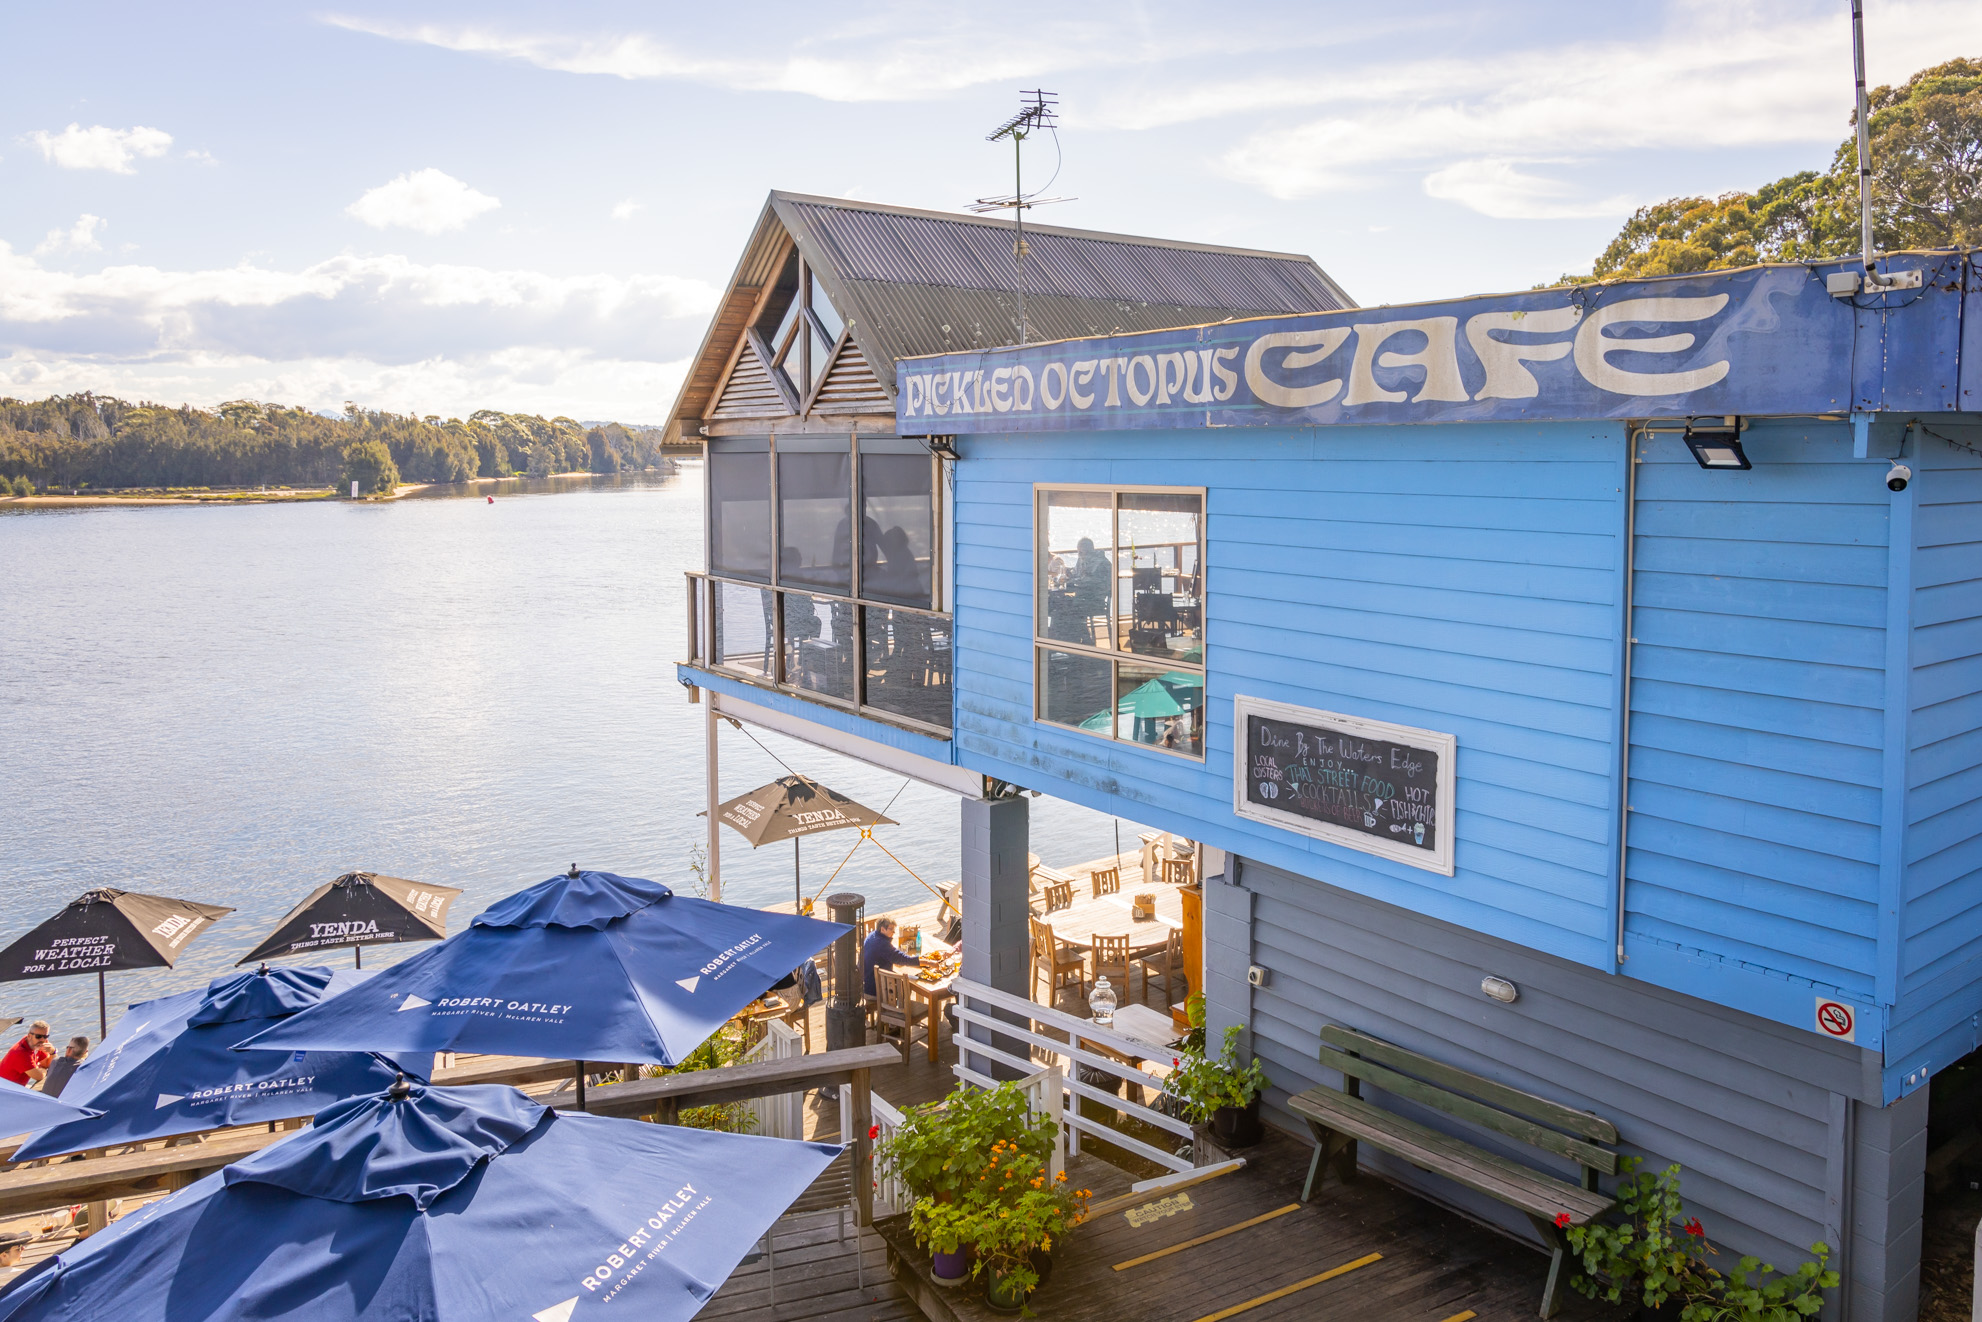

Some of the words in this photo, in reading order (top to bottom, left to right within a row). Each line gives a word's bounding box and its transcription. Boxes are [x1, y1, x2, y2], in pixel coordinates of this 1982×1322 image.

[905, 366, 1034, 417] PICKLED
[1040, 346, 1239, 411] OCTOPUS
[1244, 292, 1730, 408] CAFE
[1261, 725, 1290, 748] Dine
[1295, 731, 1310, 759] By
[1314, 735, 1334, 755] The
[1339, 739, 1383, 764] Waters
[1390, 747, 1423, 778] Edge
[1254, 755, 1278, 769] LOCAL
[1253, 766, 1284, 781] OYSTERS
[1285, 763, 1313, 784] THAI
[1317, 768, 1359, 789] STREET
[1360, 775, 1395, 800] FOOD
[1302, 782, 1372, 812] COCKTAILS
[1404, 786, 1430, 804] HOT
[792, 808, 846, 825] YENDA
[1343, 805, 1363, 823] BEER
[310, 919, 380, 938] YENDA
[51, 935, 109, 947] PERFECT
[291, 940, 319, 949] THINGS
[320, 937, 345, 945] TASTE
[346, 933, 374, 942] BETTER
[34, 944, 116, 961] WEATHER
[700, 948, 737, 975] ROBERT
[733, 933, 762, 952] OATLEY
[22, 964, 46, 973] FOR
[47, 963, 55, 971] A
[58, 955, 112, 970] LOCAL
[431, 1009, 470, 1017] MARGARET
[470, 1009, 495, 1017] RIVER
[437, 997, 504, 1008] ROBERT
[507, 1001, 573, 1015] OATLEY
[192, 1082, 254, 1099] ROBERT
[258, 1075, 316, 1090] OATLEY
[190, 1096, 228, 1107] MARGARET
[1135, 1199, 1180, 1217] CAUTION
[581, 1226, 652, 1292] ROBERT
[647, 1182, 697, 1230] OATLEY
[602, 1259, 648, 1304] MARGARET
[647, 1239, 669, 1260] RIVER
[695, 1195, 713, 1211] VALE
